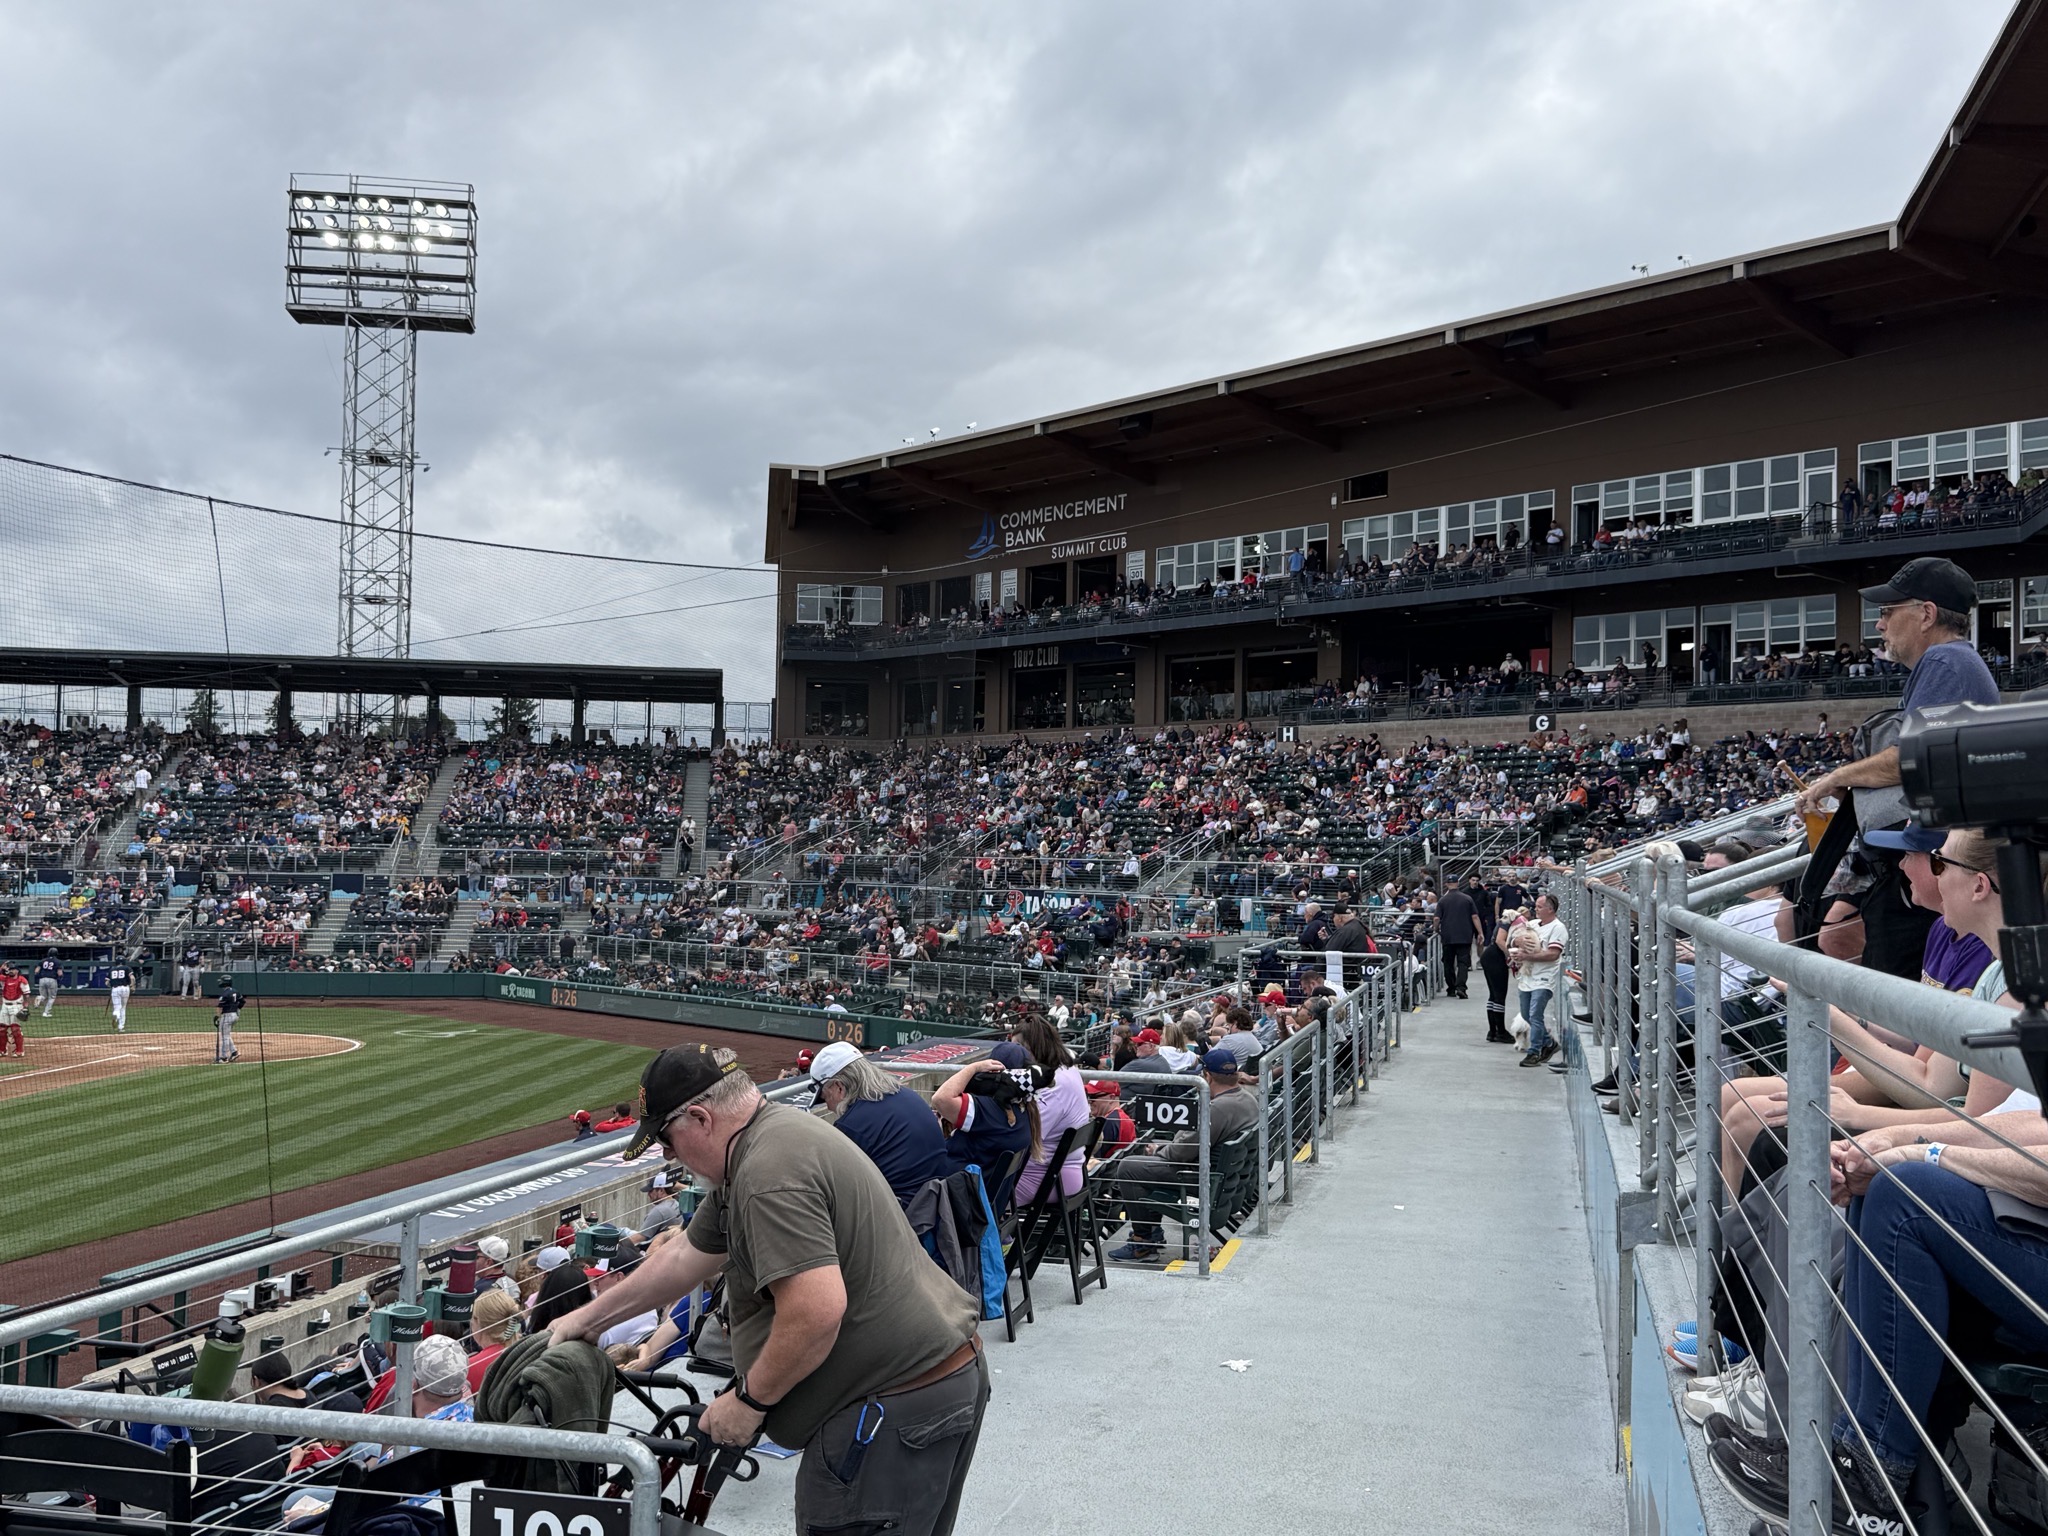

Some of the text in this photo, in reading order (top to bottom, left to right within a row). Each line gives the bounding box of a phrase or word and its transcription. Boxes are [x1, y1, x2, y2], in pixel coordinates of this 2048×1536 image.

[1000, 493, 1128, 530] COMMENCEMENT
[1005, 526, 1046, 548] BANK
[1051, 536, 1128, 559] SUMMIT CLUB
[1130, 570, 1143, 579] 301
[1005, 587, 1016, 596] 301
[1013, 646, 1059, 669] 1882 CLUB
[1536, 715, 1549, 731] G
[1282, 727, 1293, 742] H
[1968, 751, 2027, 764] Panasonic
[42, 961, 54, 970] 62
[1361, 965, 1381, 975] 106
[552, 987, 577, 1007] 0:26
[827, 1020, 863, 1045] 0:26
[897, 1031, 909, 1045] WE
[1145, 1102, 1189, 1125] 102
[633, 1133, 651, 1156] FIGHT
[157, 1360, 169, 1370] ROW
[1846, 1510, 1904, 1536] HOKA
